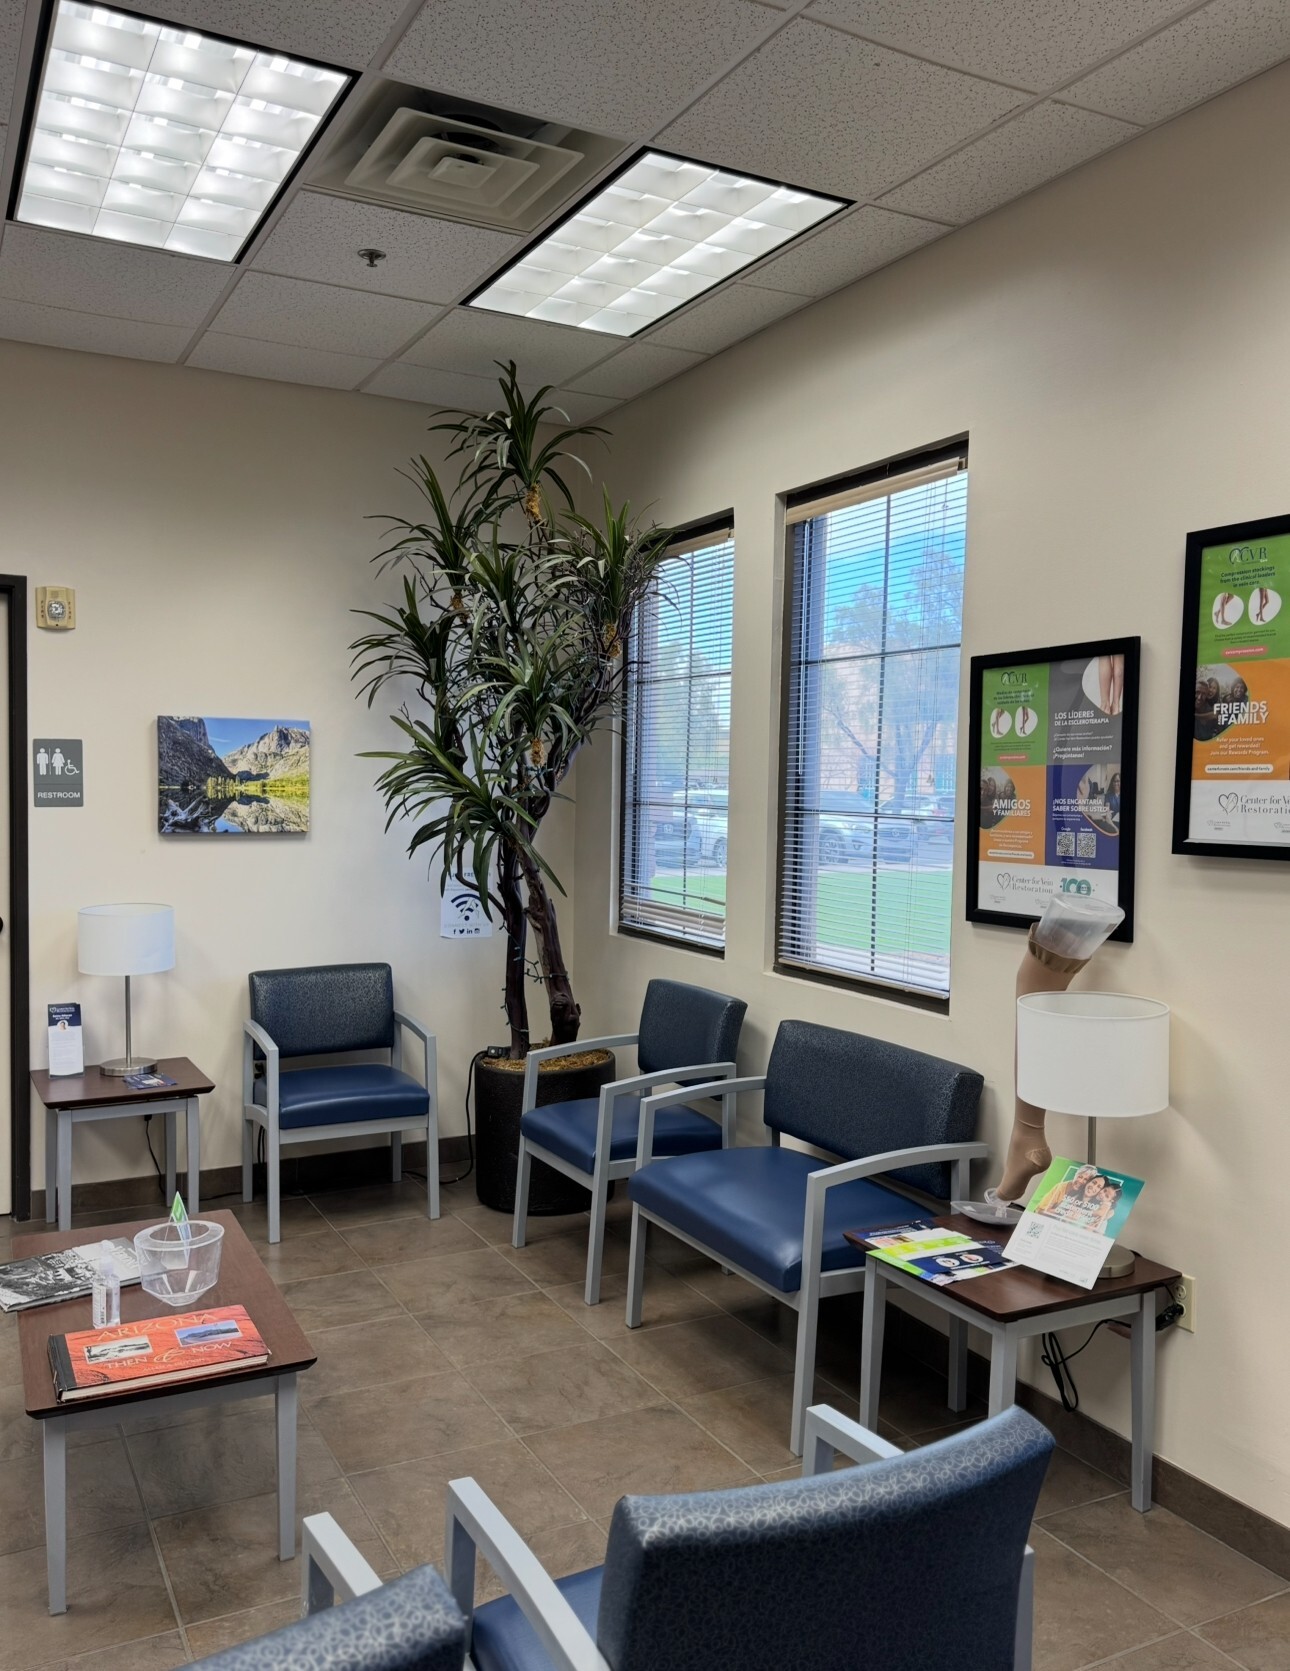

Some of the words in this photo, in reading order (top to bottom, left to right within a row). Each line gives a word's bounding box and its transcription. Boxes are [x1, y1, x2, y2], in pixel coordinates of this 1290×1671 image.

[1214, 701, 1267, 715] FRIENDS
[1054, 712, 1067, 720] LOS
[1068, 710, 1094, 718] LÍDERES
[1222, 712, 1270, 725] FAMILY
[992, 799, 1030, 810] AMIGOS
[1067, 798, 1102, 806] ENCANTARÍA
[1240, 795, 1268, 804] Center
[1269, 796, 1282, 805] for
[1012, 876, 1031, 884] Center
[1012, 883, 1053, 894] Restoration
[98, 1313, 218, 1341] ARIZONA
[106, 1357, 148, 1369] THEN
[192, 1342, 232, 1354] NOW
